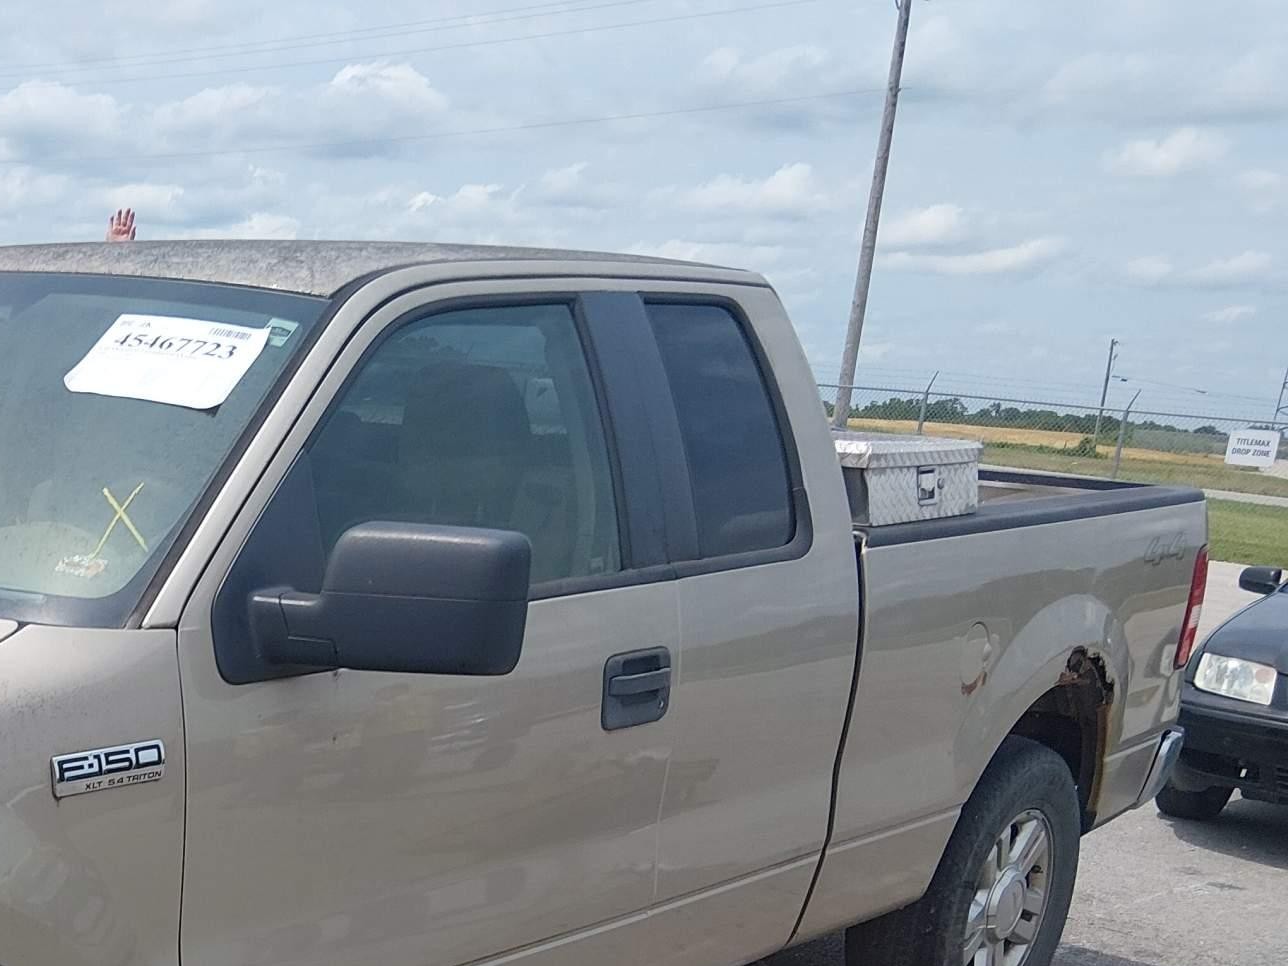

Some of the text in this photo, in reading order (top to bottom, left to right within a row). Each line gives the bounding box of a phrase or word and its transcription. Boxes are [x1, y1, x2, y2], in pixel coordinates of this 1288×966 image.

[114, 332, 238, 360] 45467723
[1237, 438, 1272, 447] TITLEMAX
[1231, 447, 1272, 457] DROP ZONE
[85, 780, 103, 791] XLT
[127, 770, 162, 783] TRITON
